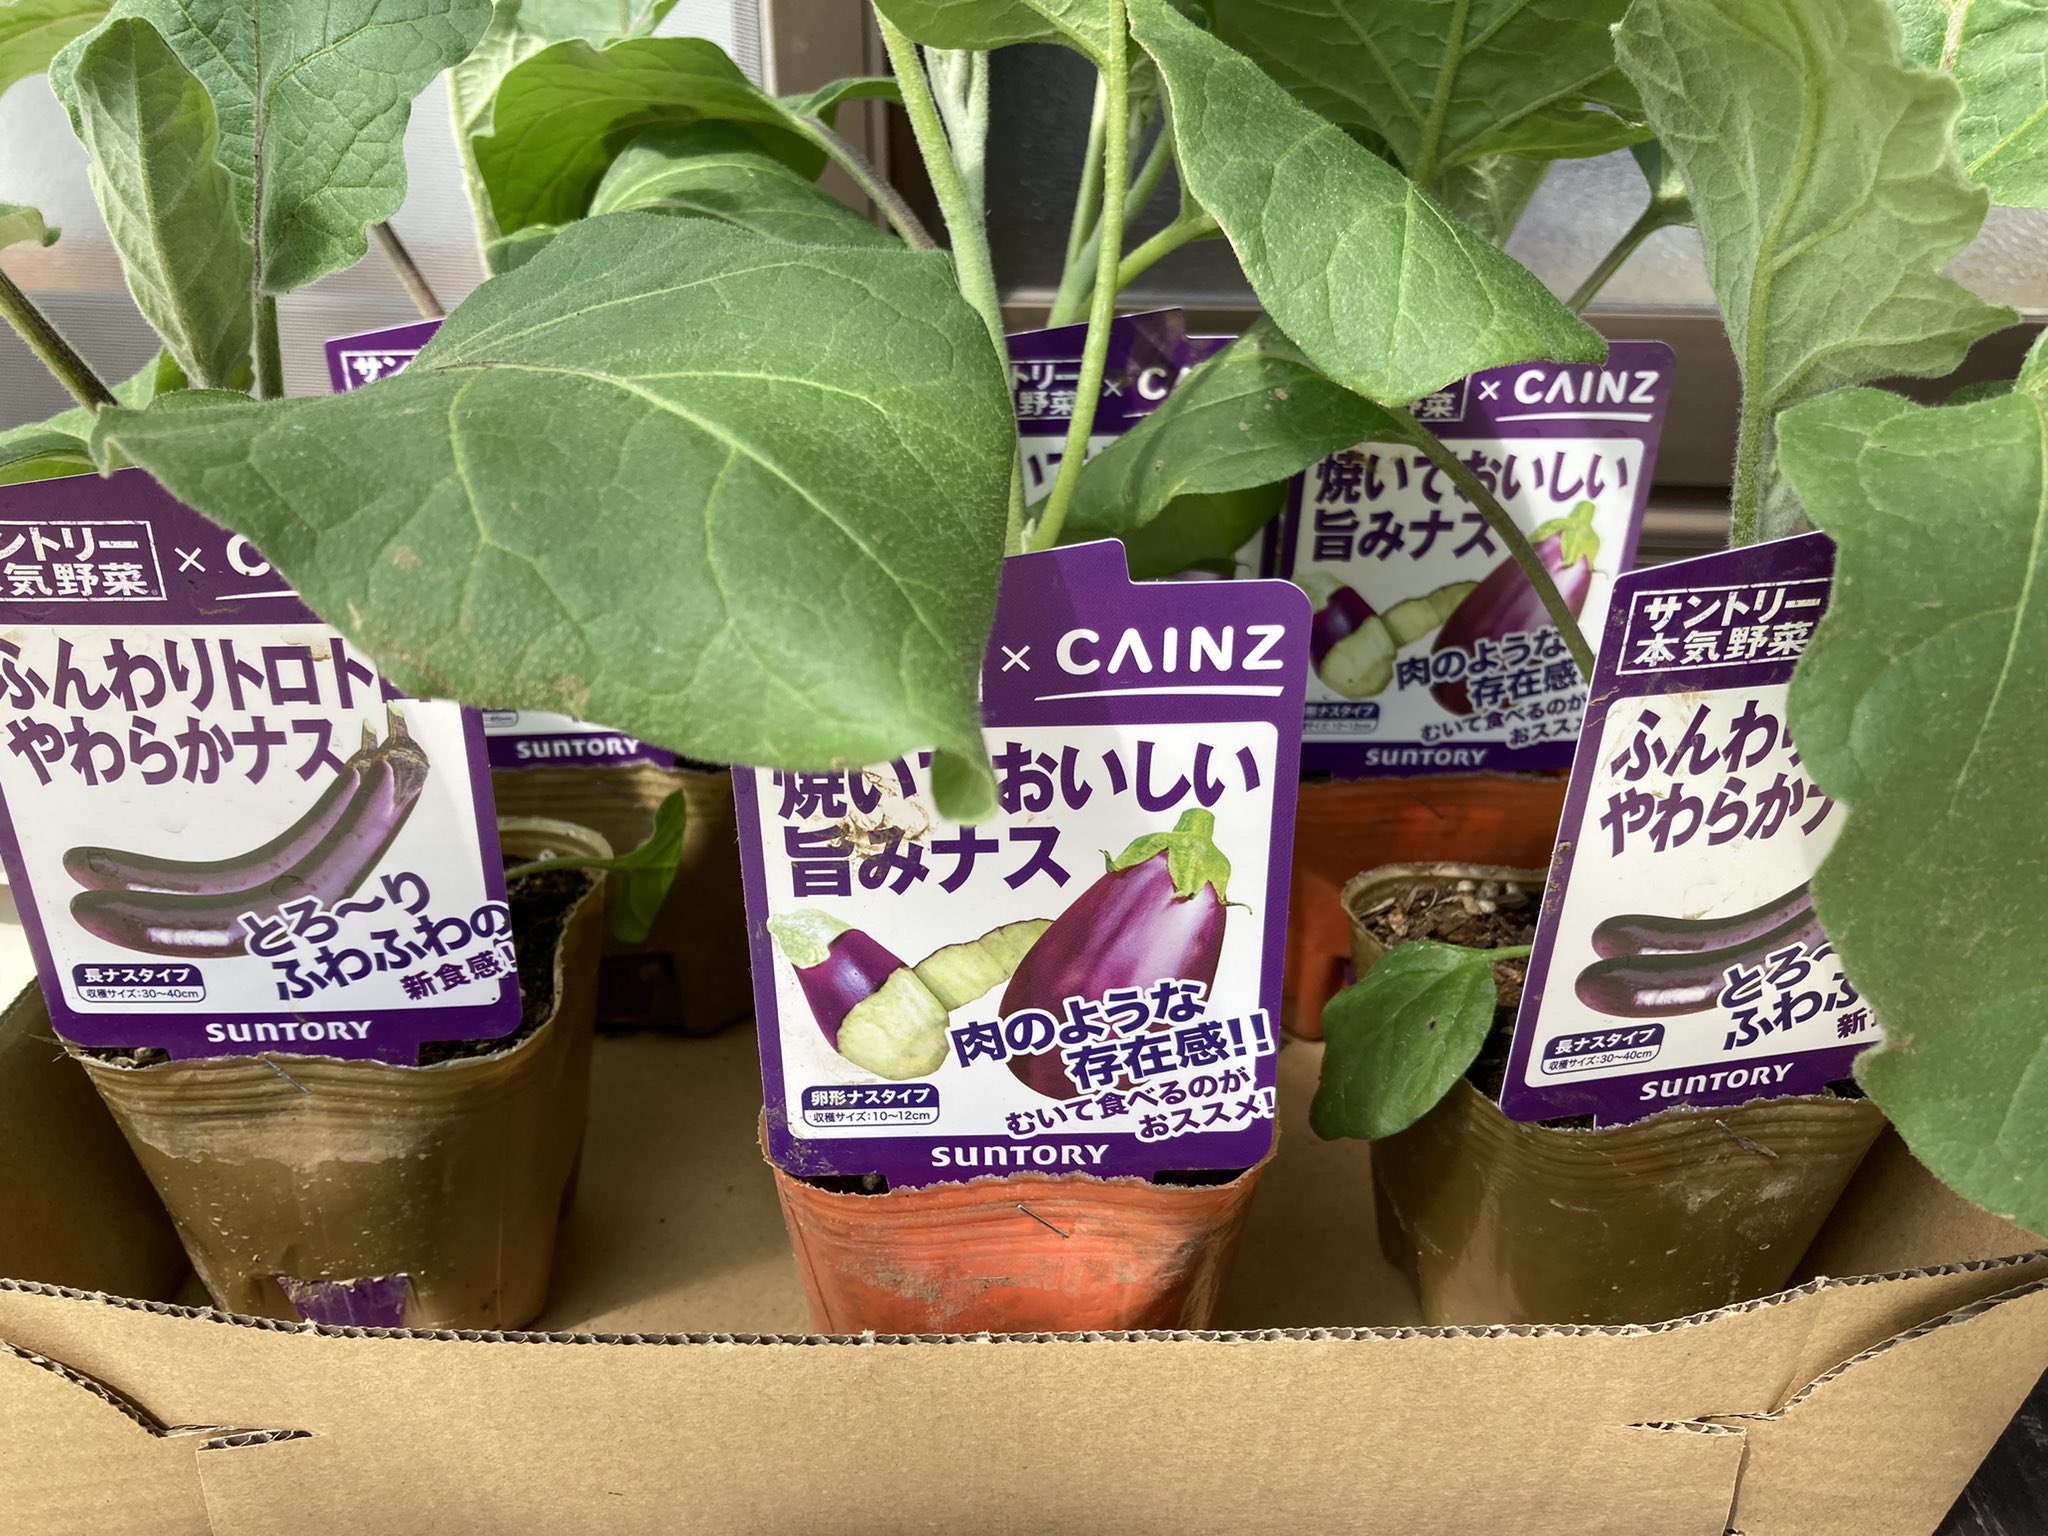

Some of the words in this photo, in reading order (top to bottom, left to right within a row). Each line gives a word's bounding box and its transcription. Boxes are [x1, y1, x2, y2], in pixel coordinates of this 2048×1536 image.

[1514, 369, 1659, 404] CAINZ
[1312, 509, 1497, 562] 旨みナス
[0, 562, 148, 597] 気野菜
[1644, 588, 1821, 632] サントリー
[1056, 624, 1286, 676] CAINZ
[1397, 628, 1568, 691] 肉のような
[1633, 621, 1813, 668] 本気野菜
[1470, 659, 1583, 708] 存在感
[1420, 694, 1586, 742] むいて食べるのが
[6, 715, 345, 786] やわらかナス
[516, 737, 639, 760] SUNTORY
[1365, 748, 1488, 767] SUNTORY
[772, 741, 1260, 813] 焼いおいしい
[784, 825, 1072, 898] 旨みナス
[84, 968, 190, 983] 長ナスタイプ
[271, 904, 510, 1001] ふわふわの
[204, 1020, 372, 1044] SUNTORY
[951, 982, 1205, 1068] 肉のような
[1554, 1028, 1656, 1055] 長ナスタイプ
[1837, 1006, 1879, 1040] 新
[1067, 1013, 1271, 1090] 存在感!!
[810, 1087, 930, 1106] 卵形ナスタイプ
[1005, 1066, 1251, 1136] むいて食べるのが
[1639, 1062, 1795, 1101] SUNTORY
[1139, 1091, 1275, 1139] おススメ!
[931, 1144, 1109, 1167] SUNTORY
